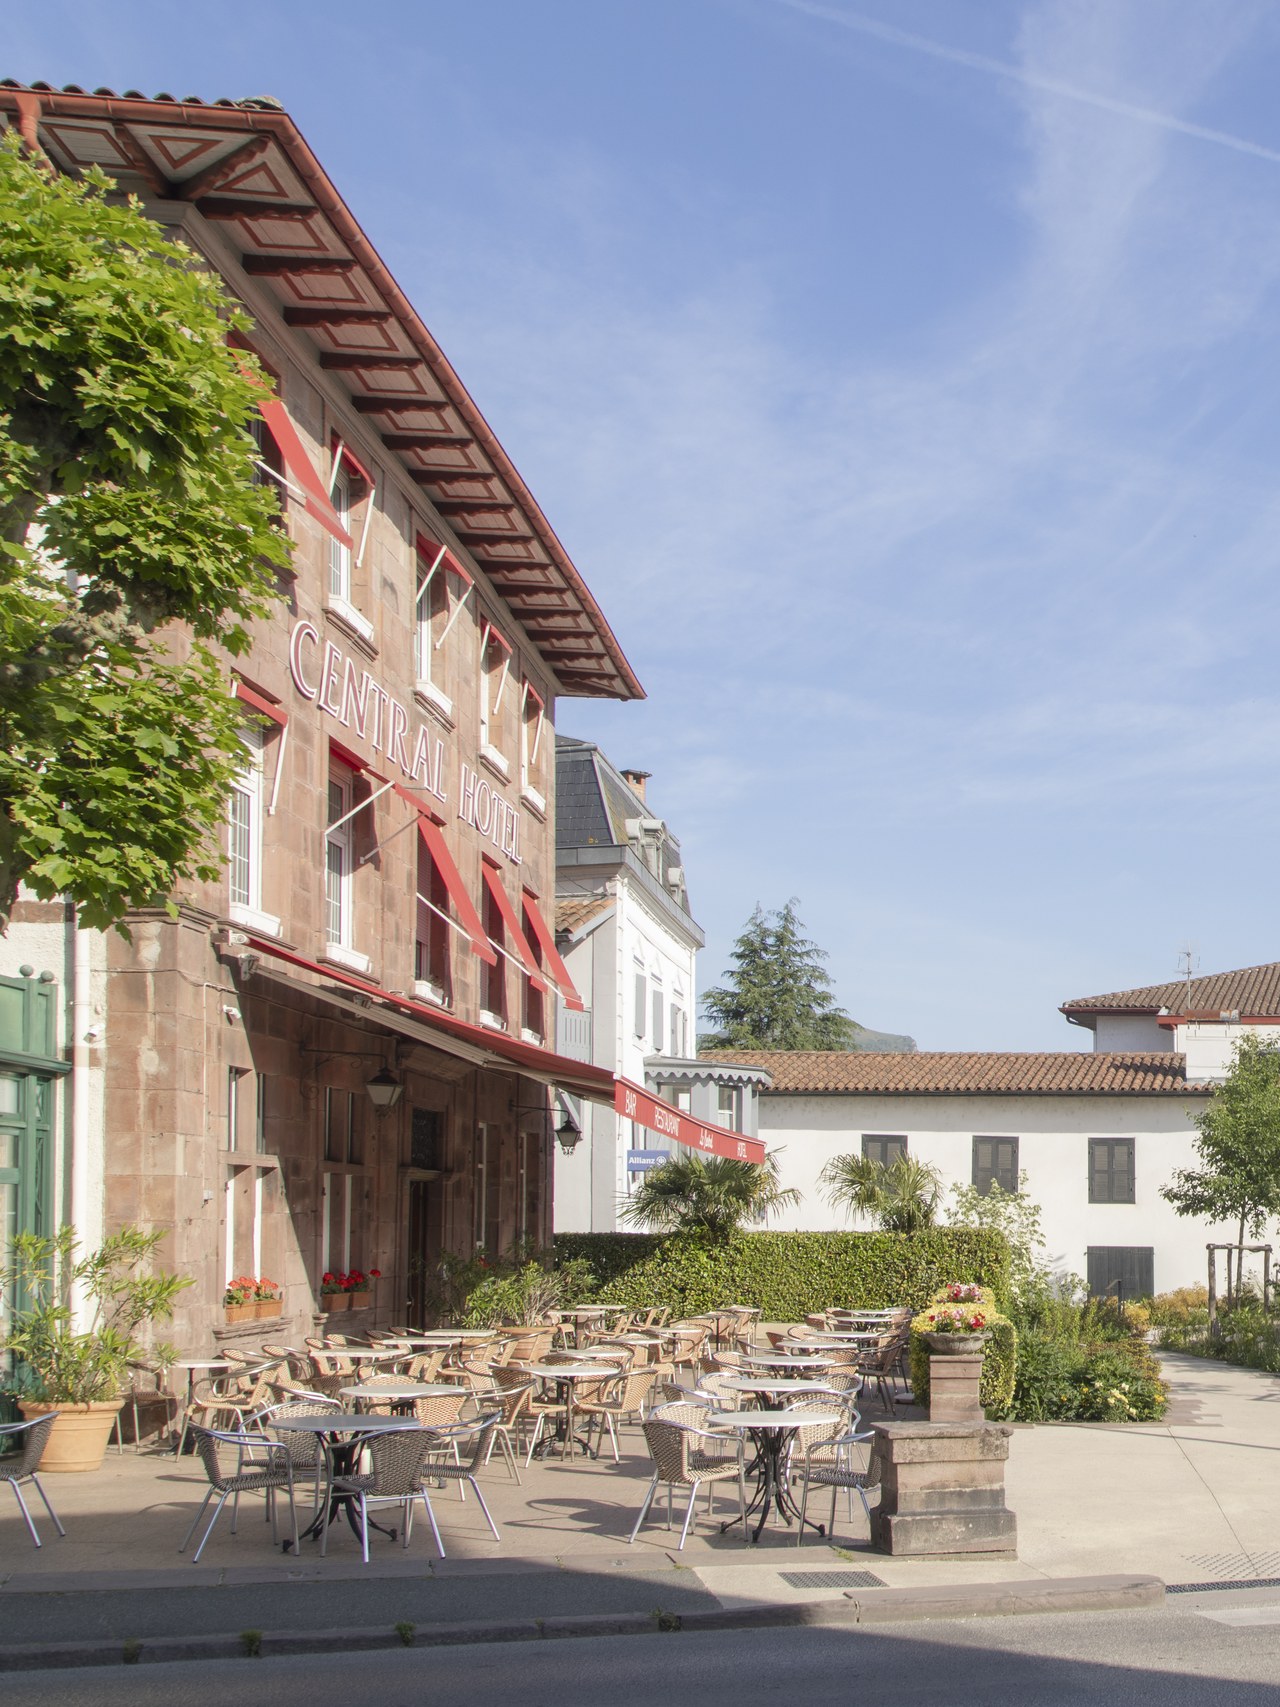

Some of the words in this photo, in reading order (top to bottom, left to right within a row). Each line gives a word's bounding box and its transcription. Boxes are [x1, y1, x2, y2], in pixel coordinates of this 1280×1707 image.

[290, 620, 447, 804] CENTRAL
[458, 763, 523, 865] HOTEL
[625, 1090, 637, 1117] BAR
[628, 1156, 656, 1165] Allianz
